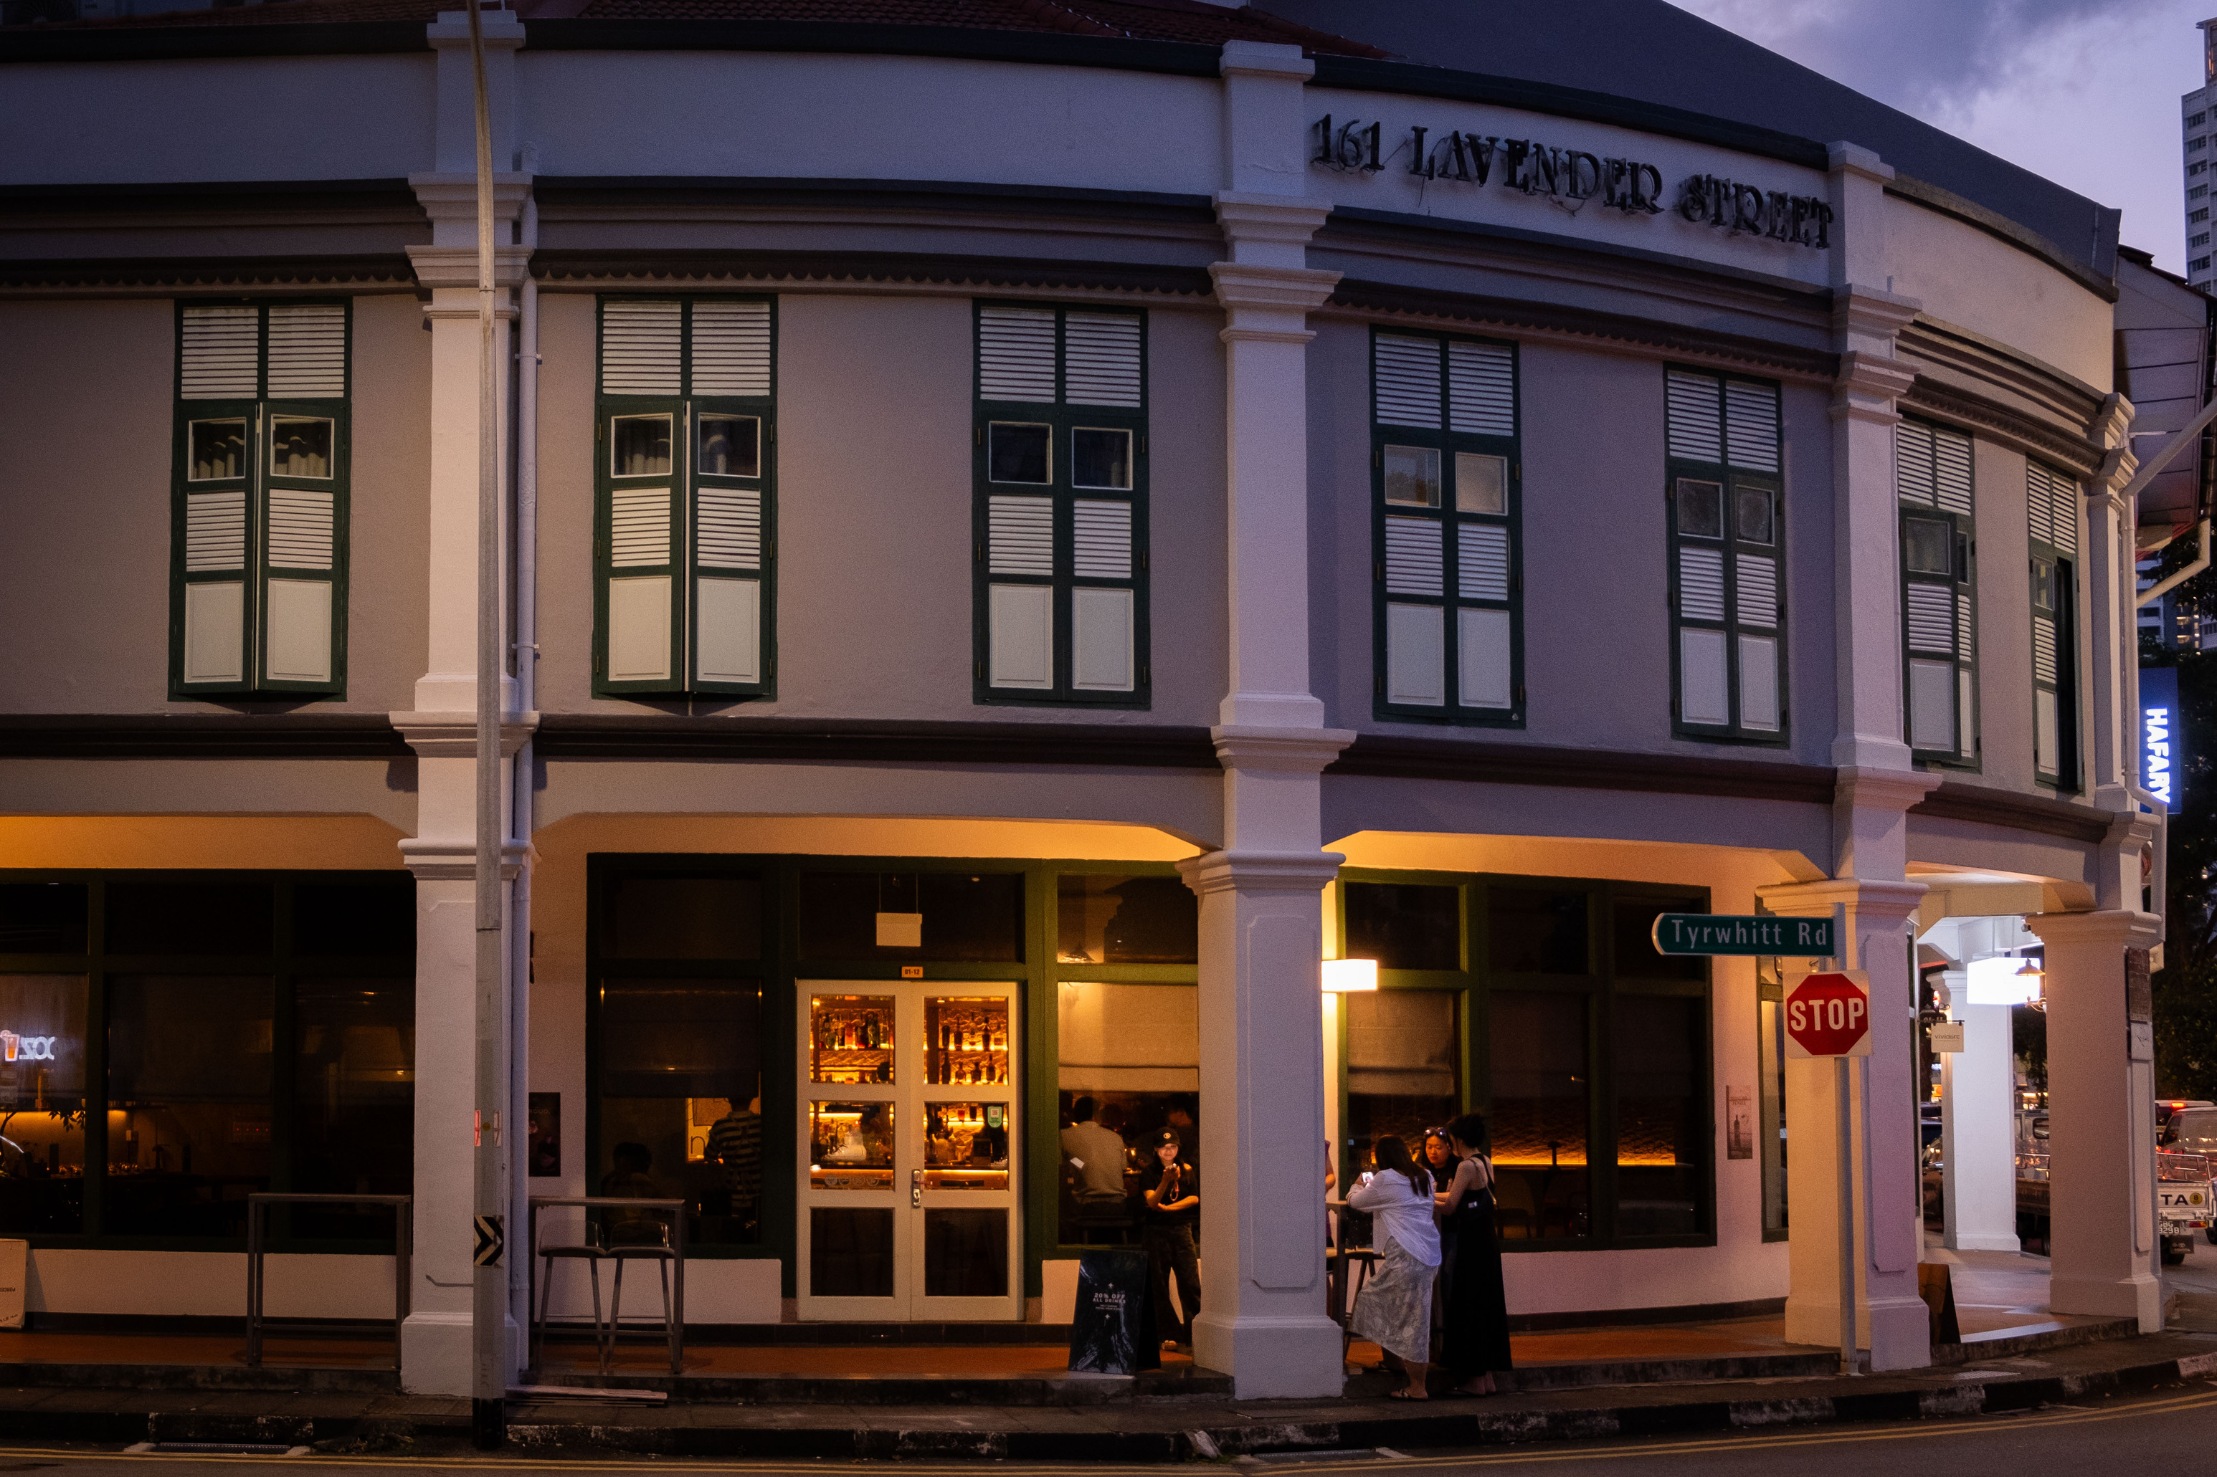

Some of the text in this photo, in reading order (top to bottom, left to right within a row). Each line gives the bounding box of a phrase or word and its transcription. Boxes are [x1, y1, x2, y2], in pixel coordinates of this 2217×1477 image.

[1311, 113, 1835, 249] 161 LAVENDER STREET
[2146, 708, 2170, 804] HAFARY
[1672, 919, 1826, 949] Tyrwhitt Rd
[1790, 998, 1864, 1031] STOP
[2160, 1194, 2189, 1205] TA
